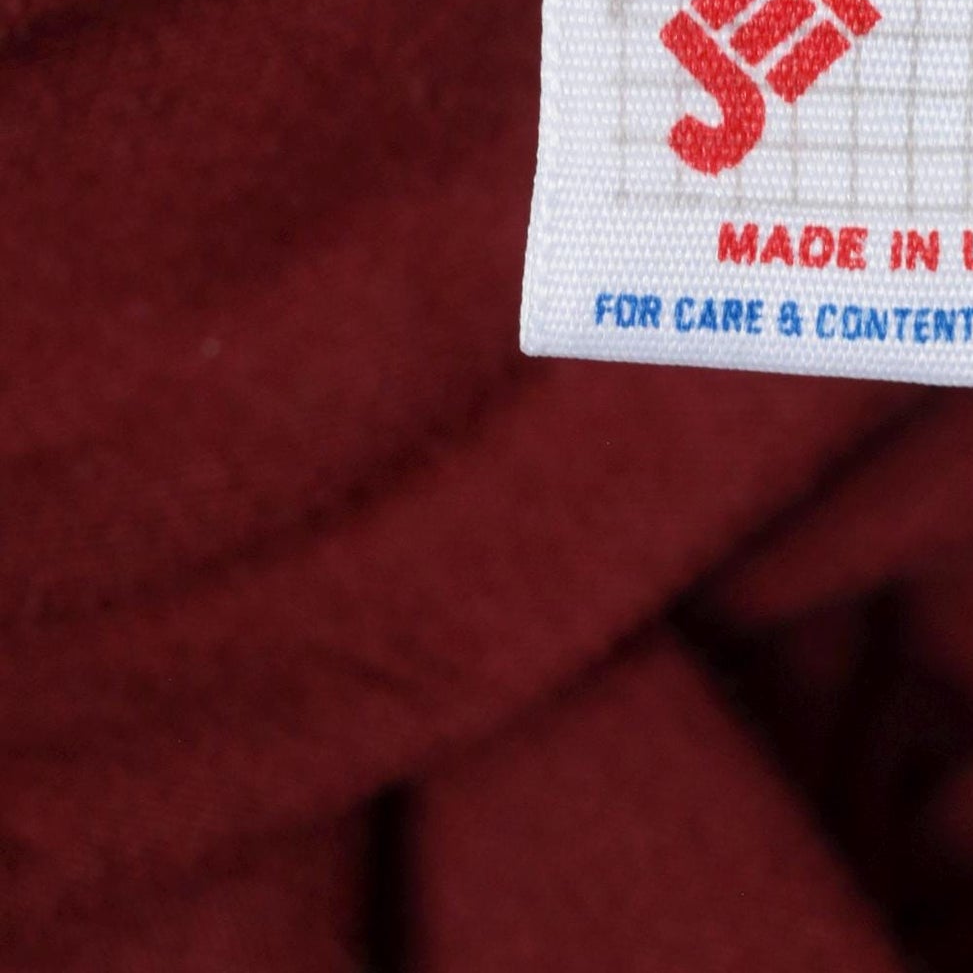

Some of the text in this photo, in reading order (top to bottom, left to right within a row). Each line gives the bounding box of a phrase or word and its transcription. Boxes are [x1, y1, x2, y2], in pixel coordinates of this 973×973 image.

[717, 222, 868, 270] MADE
[890, 230, 940, 272] IN
[594, 292, 663, 329] FOR
[673, 295, 765, 334] CARE
[776, 300, 804, 338] &
